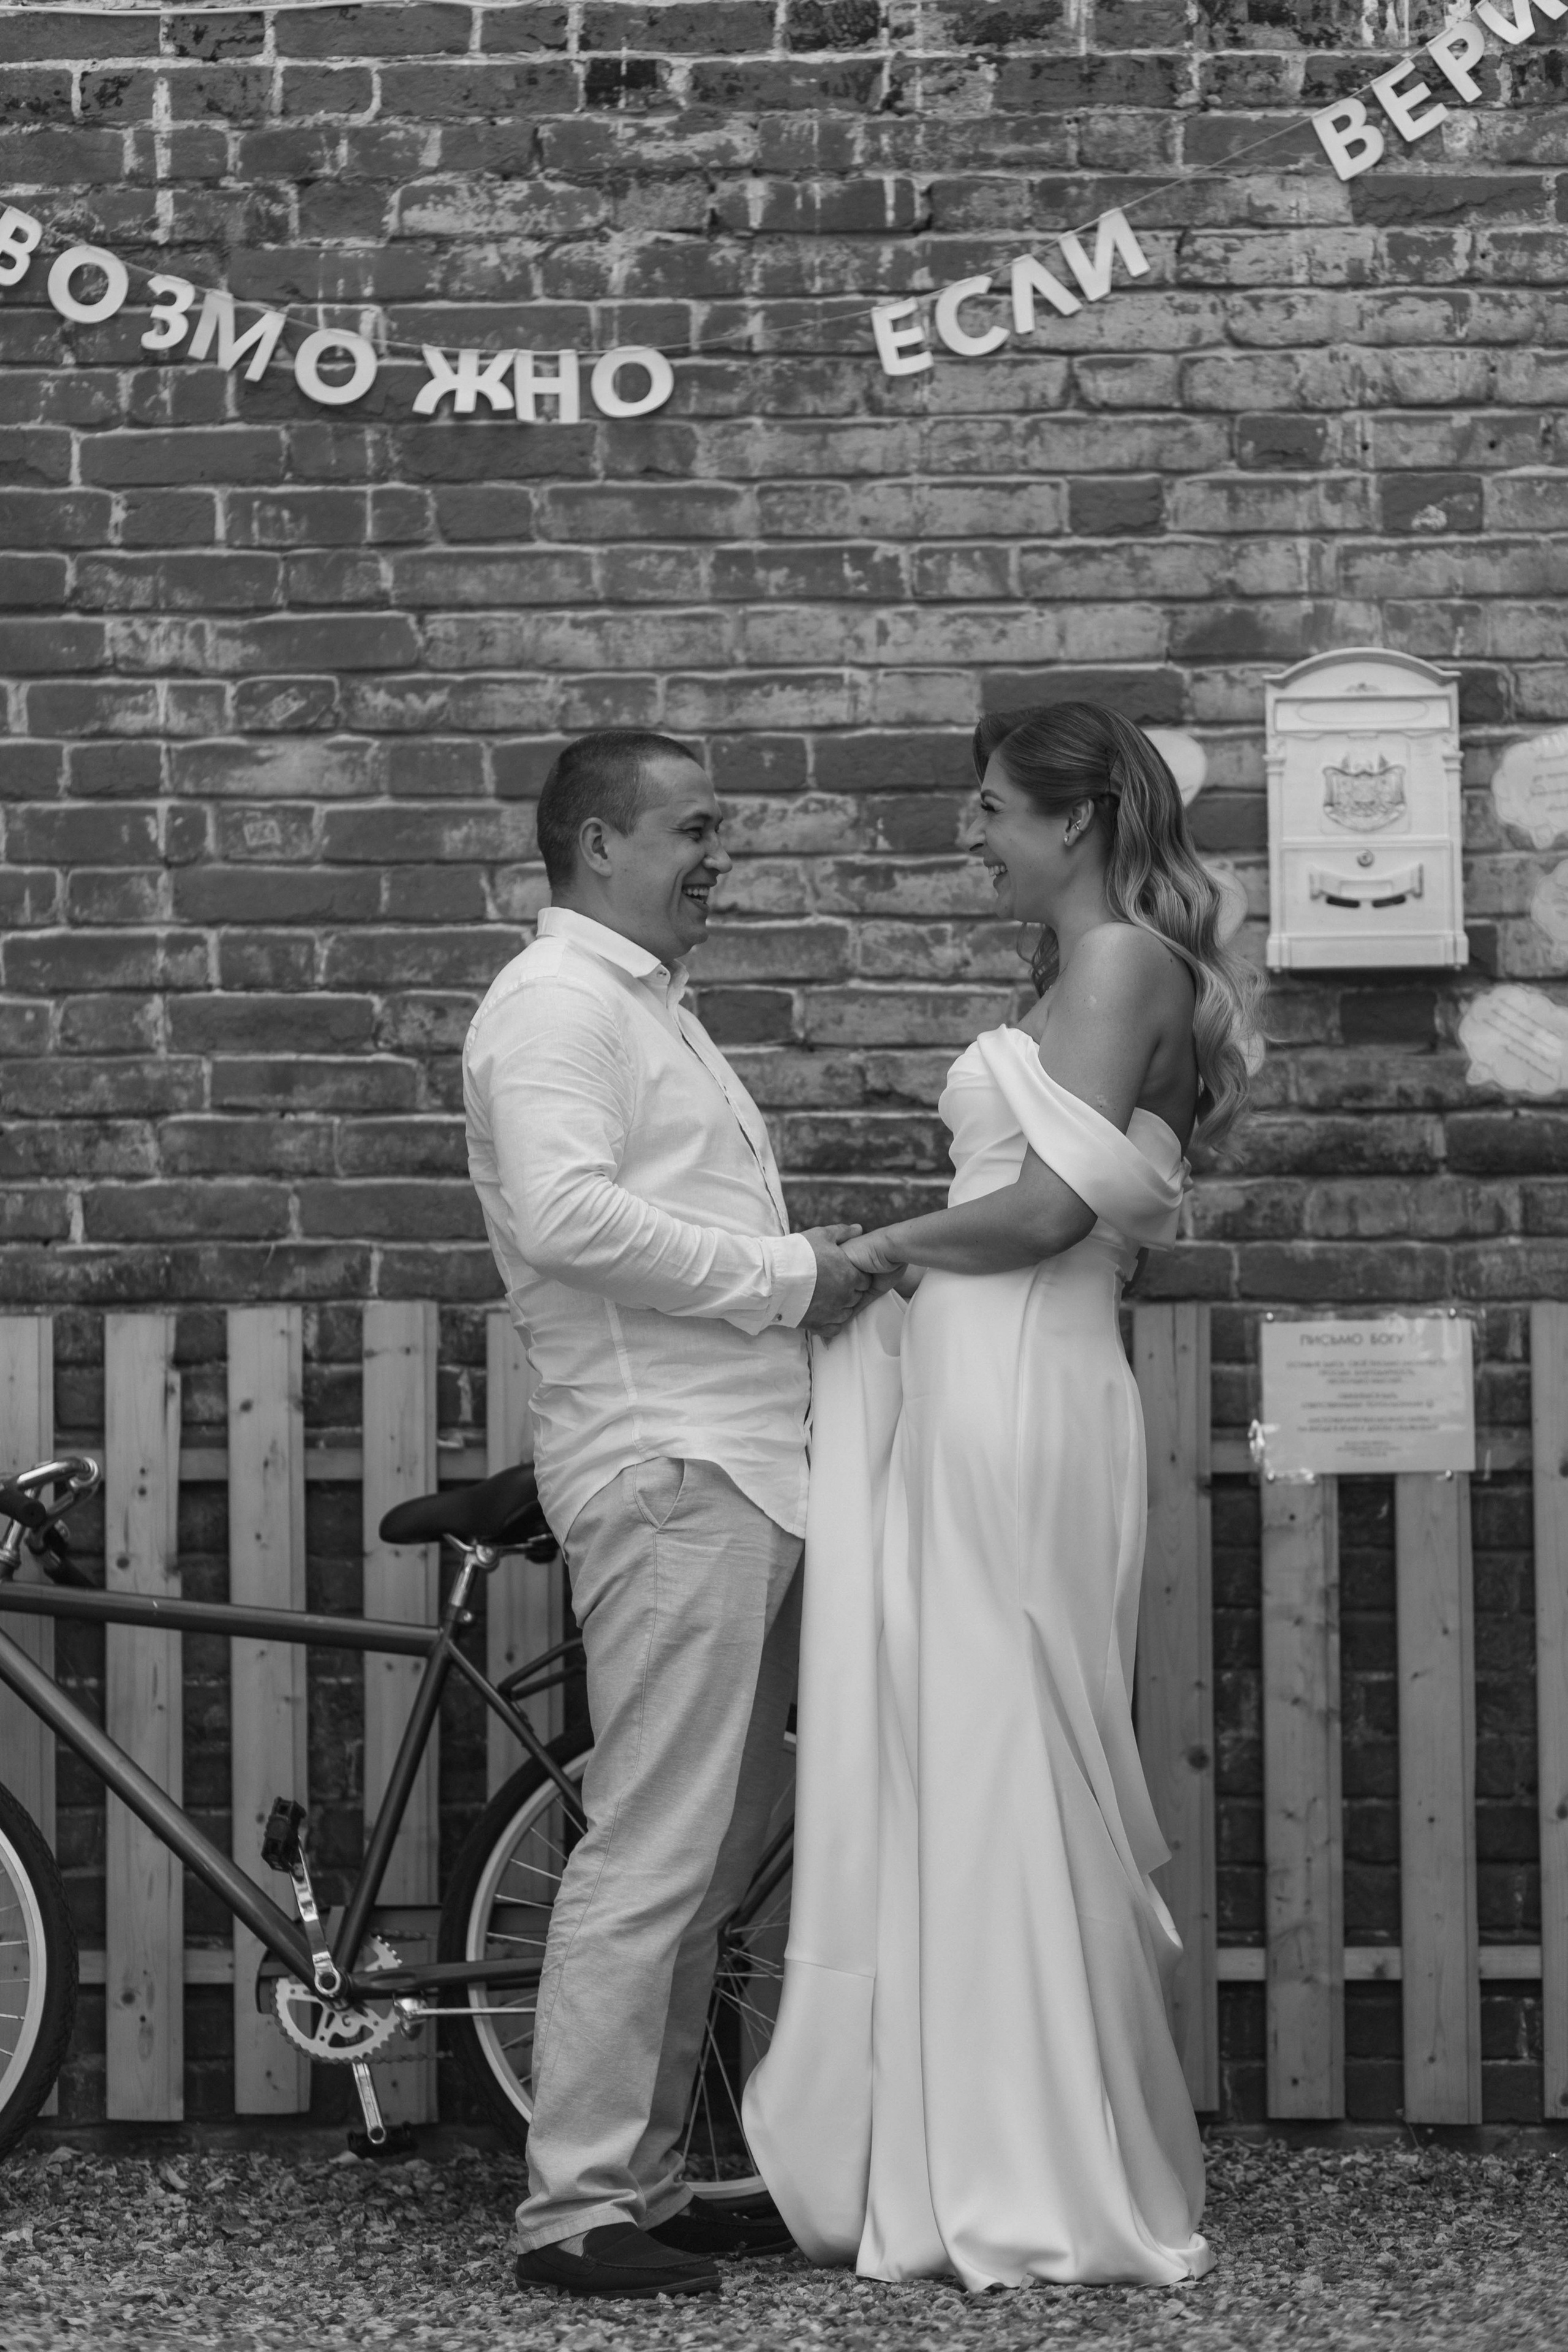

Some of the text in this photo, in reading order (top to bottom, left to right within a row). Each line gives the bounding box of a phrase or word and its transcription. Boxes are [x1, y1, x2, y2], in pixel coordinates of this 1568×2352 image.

[0, 205, 674, 423] ВОЗМОЖНО
[871, 208, 1151, 376] ЕСЛИ
[1300, 1332, 1404, 1346] ПИСЬМО БОГУ
